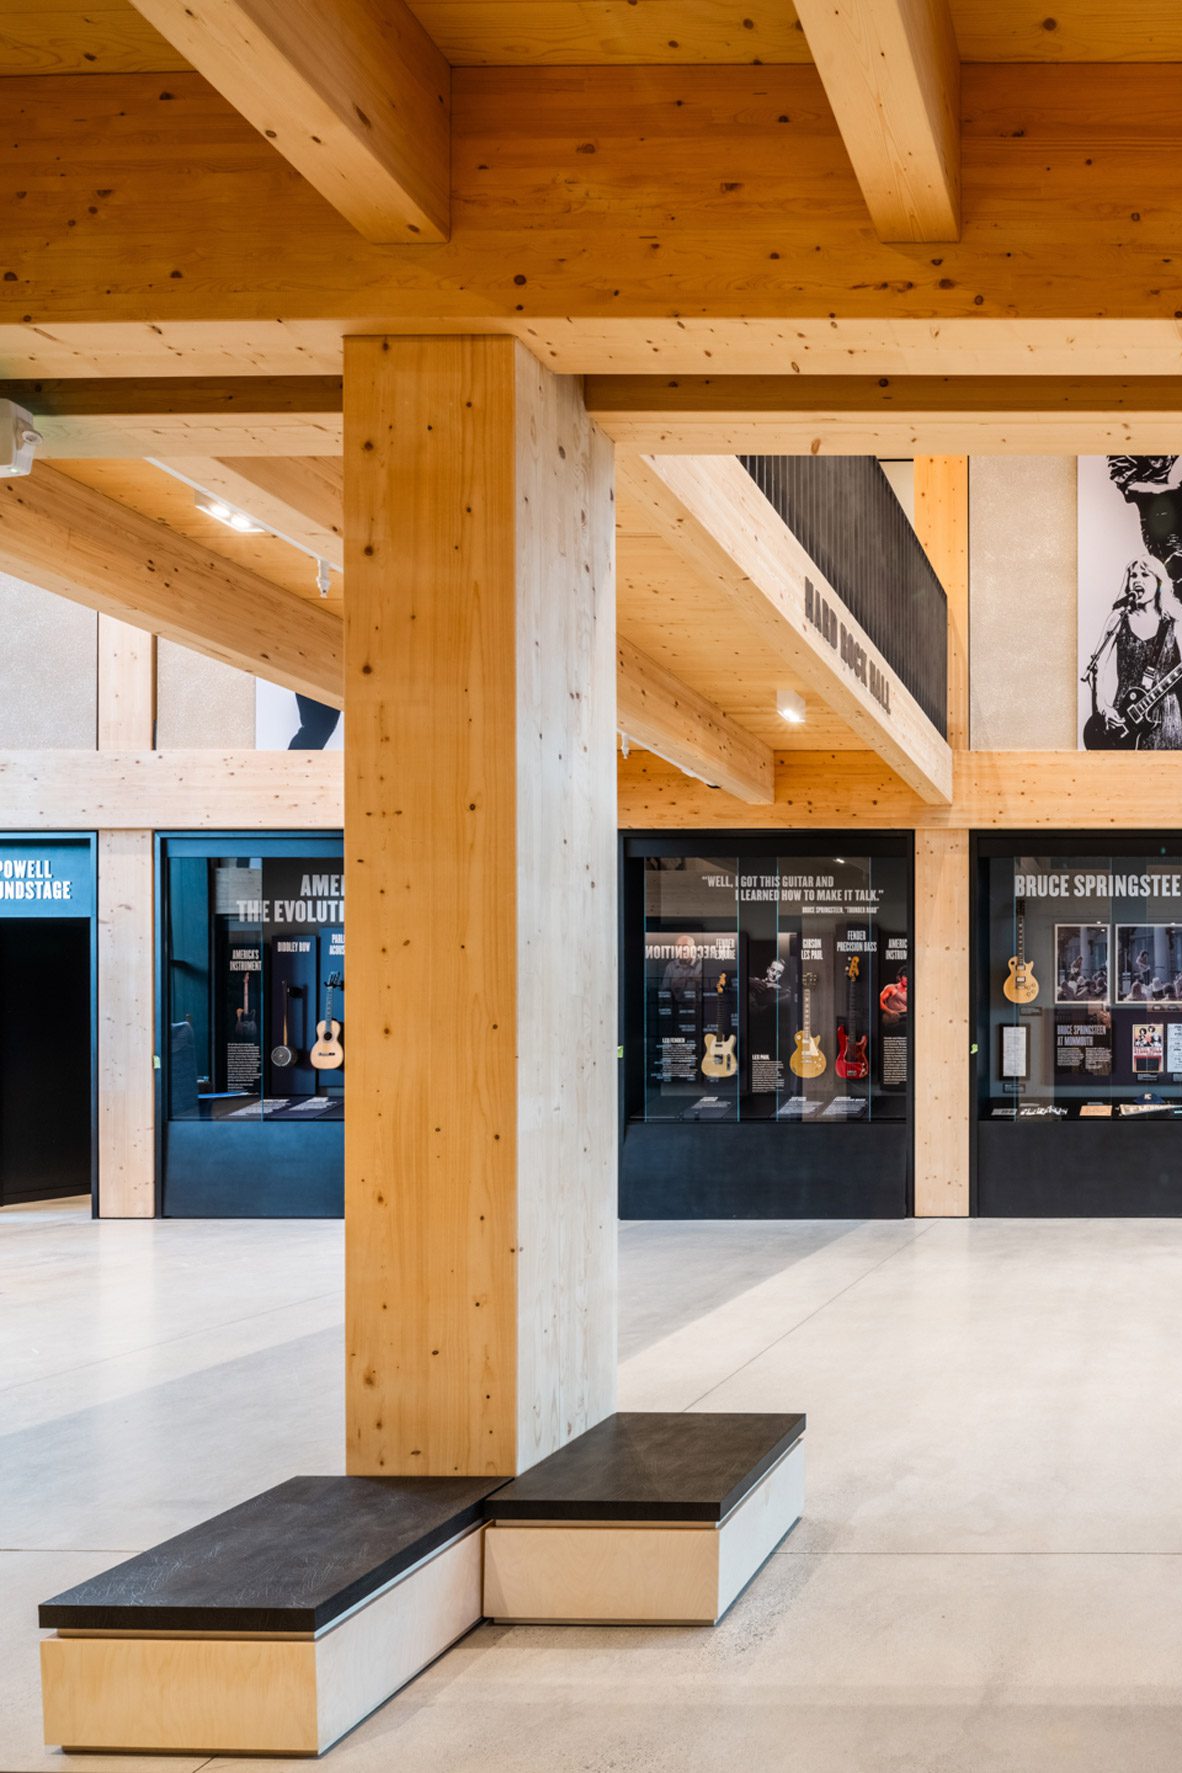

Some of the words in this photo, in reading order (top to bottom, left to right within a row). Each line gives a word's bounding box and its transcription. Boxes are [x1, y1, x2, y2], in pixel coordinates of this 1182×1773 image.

[804, 575, 838, 650] HARD
[840, 621, 868, 689] ROCK
[300, 874, 344, 897] AME
[741, 875, 757, 887] GOT
[759, 875, 780, 888] THIS
[782, 875, 814, 887] GUITAR
[815, 875, 834, 887] AND
[1013, 874, 1070, 897] BRUCE
[741, 889, 779, 901] LEARNED
[781, 889, 801, 901] HOW
[803, 889, 815, 901] TO
[816, 889, 842, 901] MAKE
[844, 889, 852, 901] IT
[236, 900, 271, 922] THE
[847, 930, 866, 940] FENDER
[298, 941, 311, 953] BOW
[802, 938, 822, 949] GIBSON
[836, 941, 863, 952] PRECISION
[864, 941, 877, 952] BASS
[232, 949, 260, 960] AMERICA'S
[801, 949, 811, 960] LES
[229, 960, 262, 972] INSTRUMENT
[1057, 1024, 1073, 1035] BRUCE
[1073, 1024, 1107, 1035] SPRINGSTEEN
